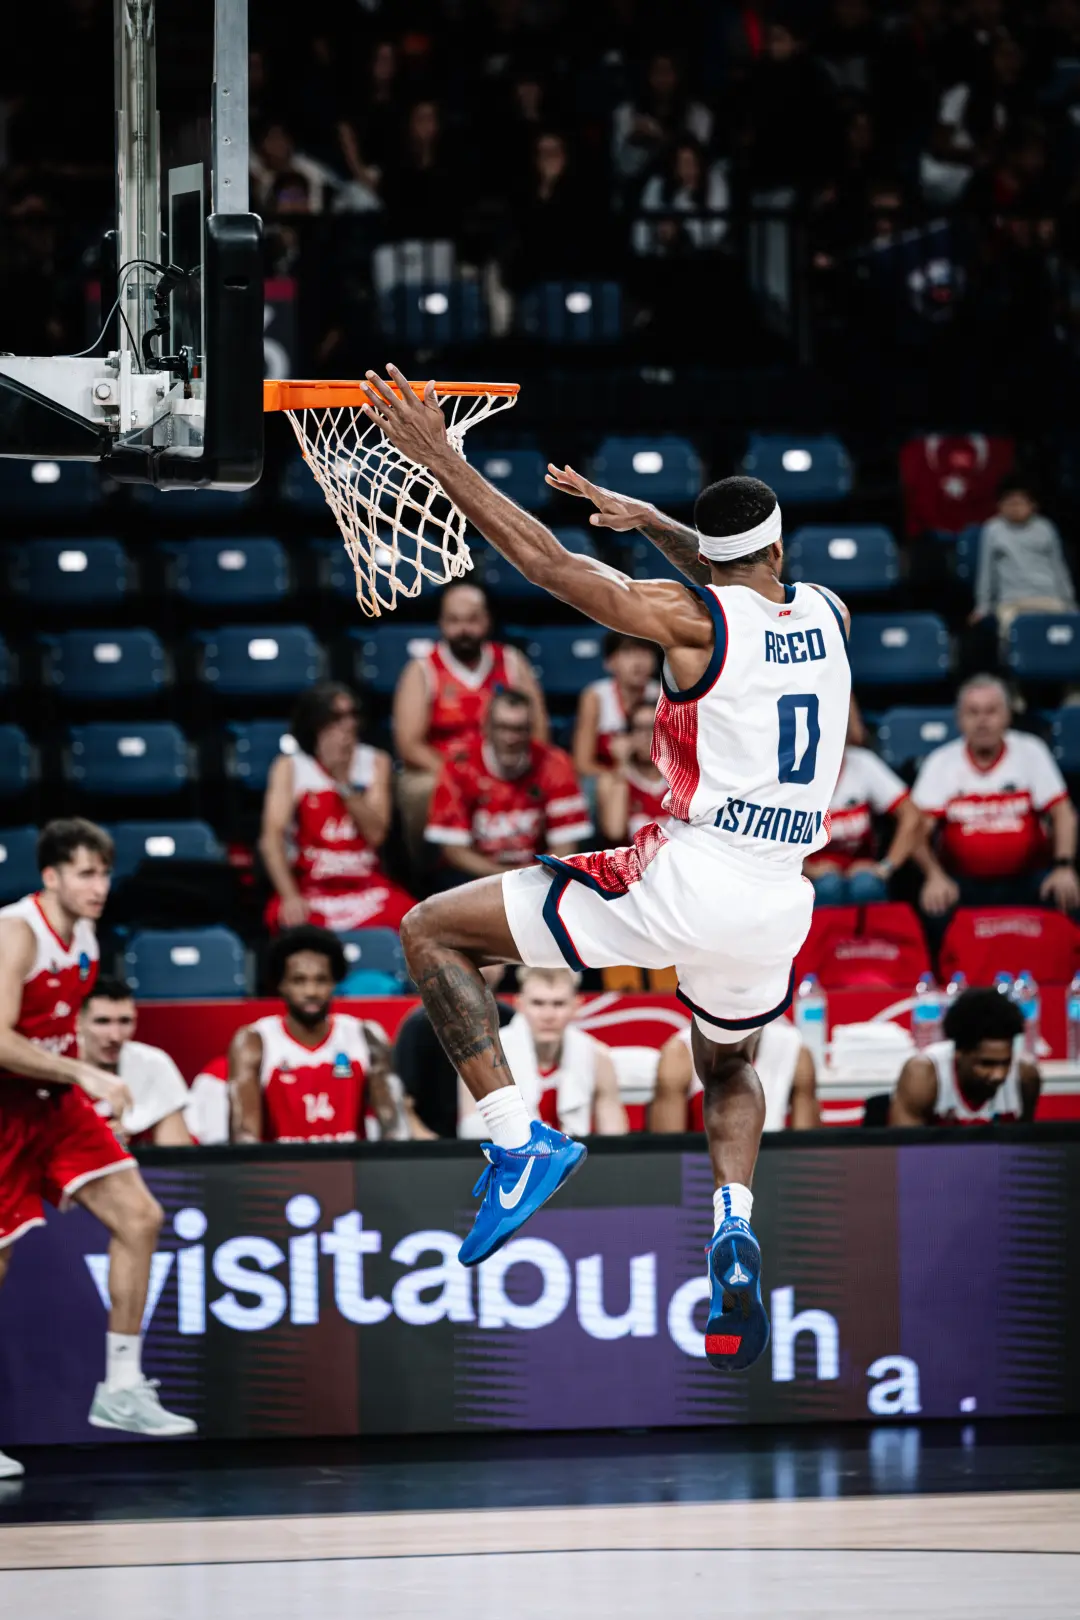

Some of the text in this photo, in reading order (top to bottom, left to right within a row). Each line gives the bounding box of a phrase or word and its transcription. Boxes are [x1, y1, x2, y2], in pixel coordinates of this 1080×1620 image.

[764, 627, 827, 664] REED
[776, 693, 821, 785] 0
[713, 796, 822, 845] İSTANBU
[301, 1091, 336, 1123] 14
